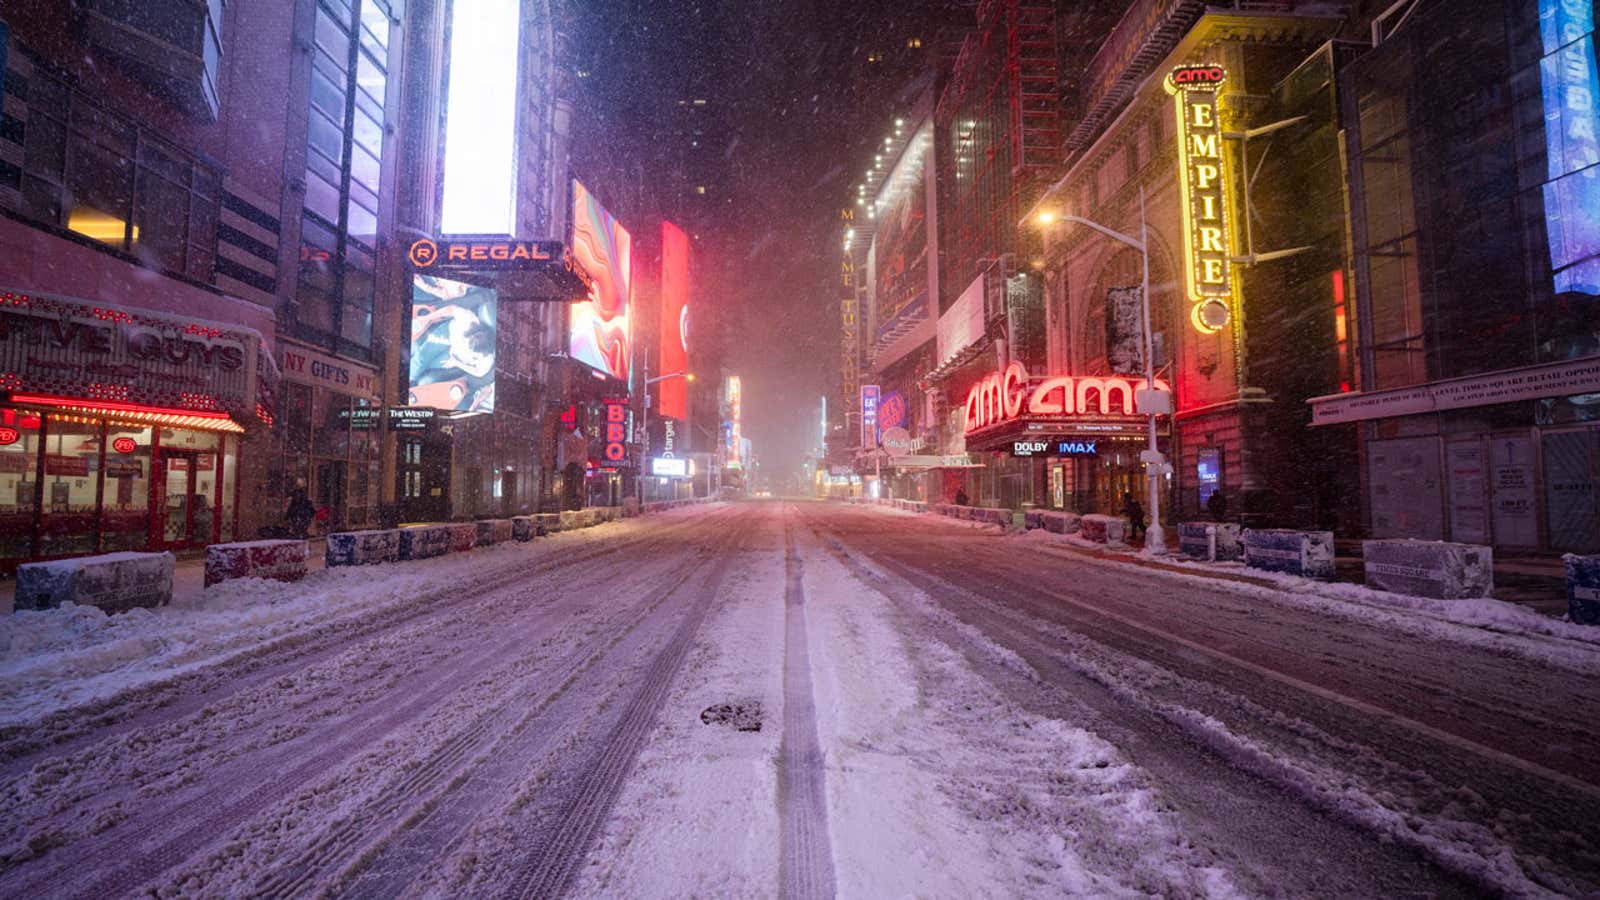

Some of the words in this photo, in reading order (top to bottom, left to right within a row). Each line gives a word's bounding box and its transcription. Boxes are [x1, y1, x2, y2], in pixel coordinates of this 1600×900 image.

[1191, 103, 1225, 285] EMPIRE
[448, 243, 550, 260] REGAL
[126, 330, 244, 369] GUYS
[284, 352, 306, 373] NY
[311, 360, 349, 385] GIFTS
[355, 374, 372, 391] NY
[0, 430, 18, 442] PEN
[114, 439, 135, 450] OPEN
[607, 404, 625, 461] BBQ
[664, 420, 675, 451] target
[1014, 441, 1048, 452] DOLBY
[1058, 442, 1097, 455] IMAX
